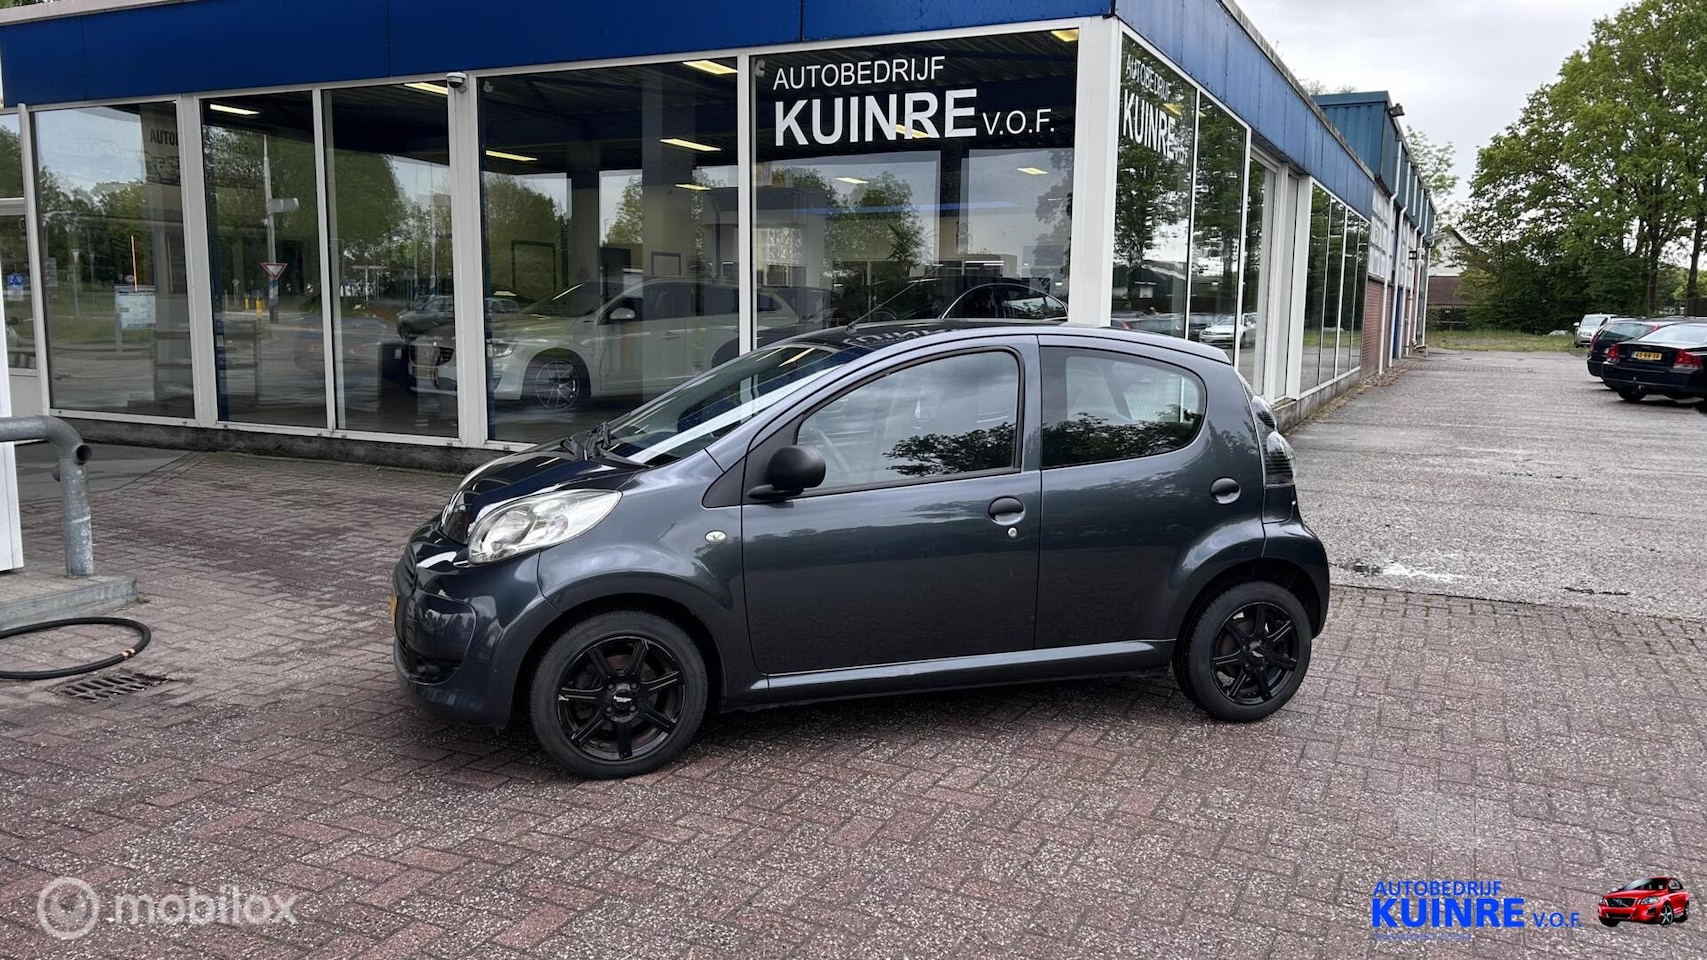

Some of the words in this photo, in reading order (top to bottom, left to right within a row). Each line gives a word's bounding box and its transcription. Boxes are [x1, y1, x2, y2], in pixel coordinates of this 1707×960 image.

[773, 56, 946, 91] AUTOBEDRIJF
[774, 88, 979, 147] KUINRE
[982, 108, 1056, 136] V.O.F.
[1122, 89, 1176, 161] KUINRE
